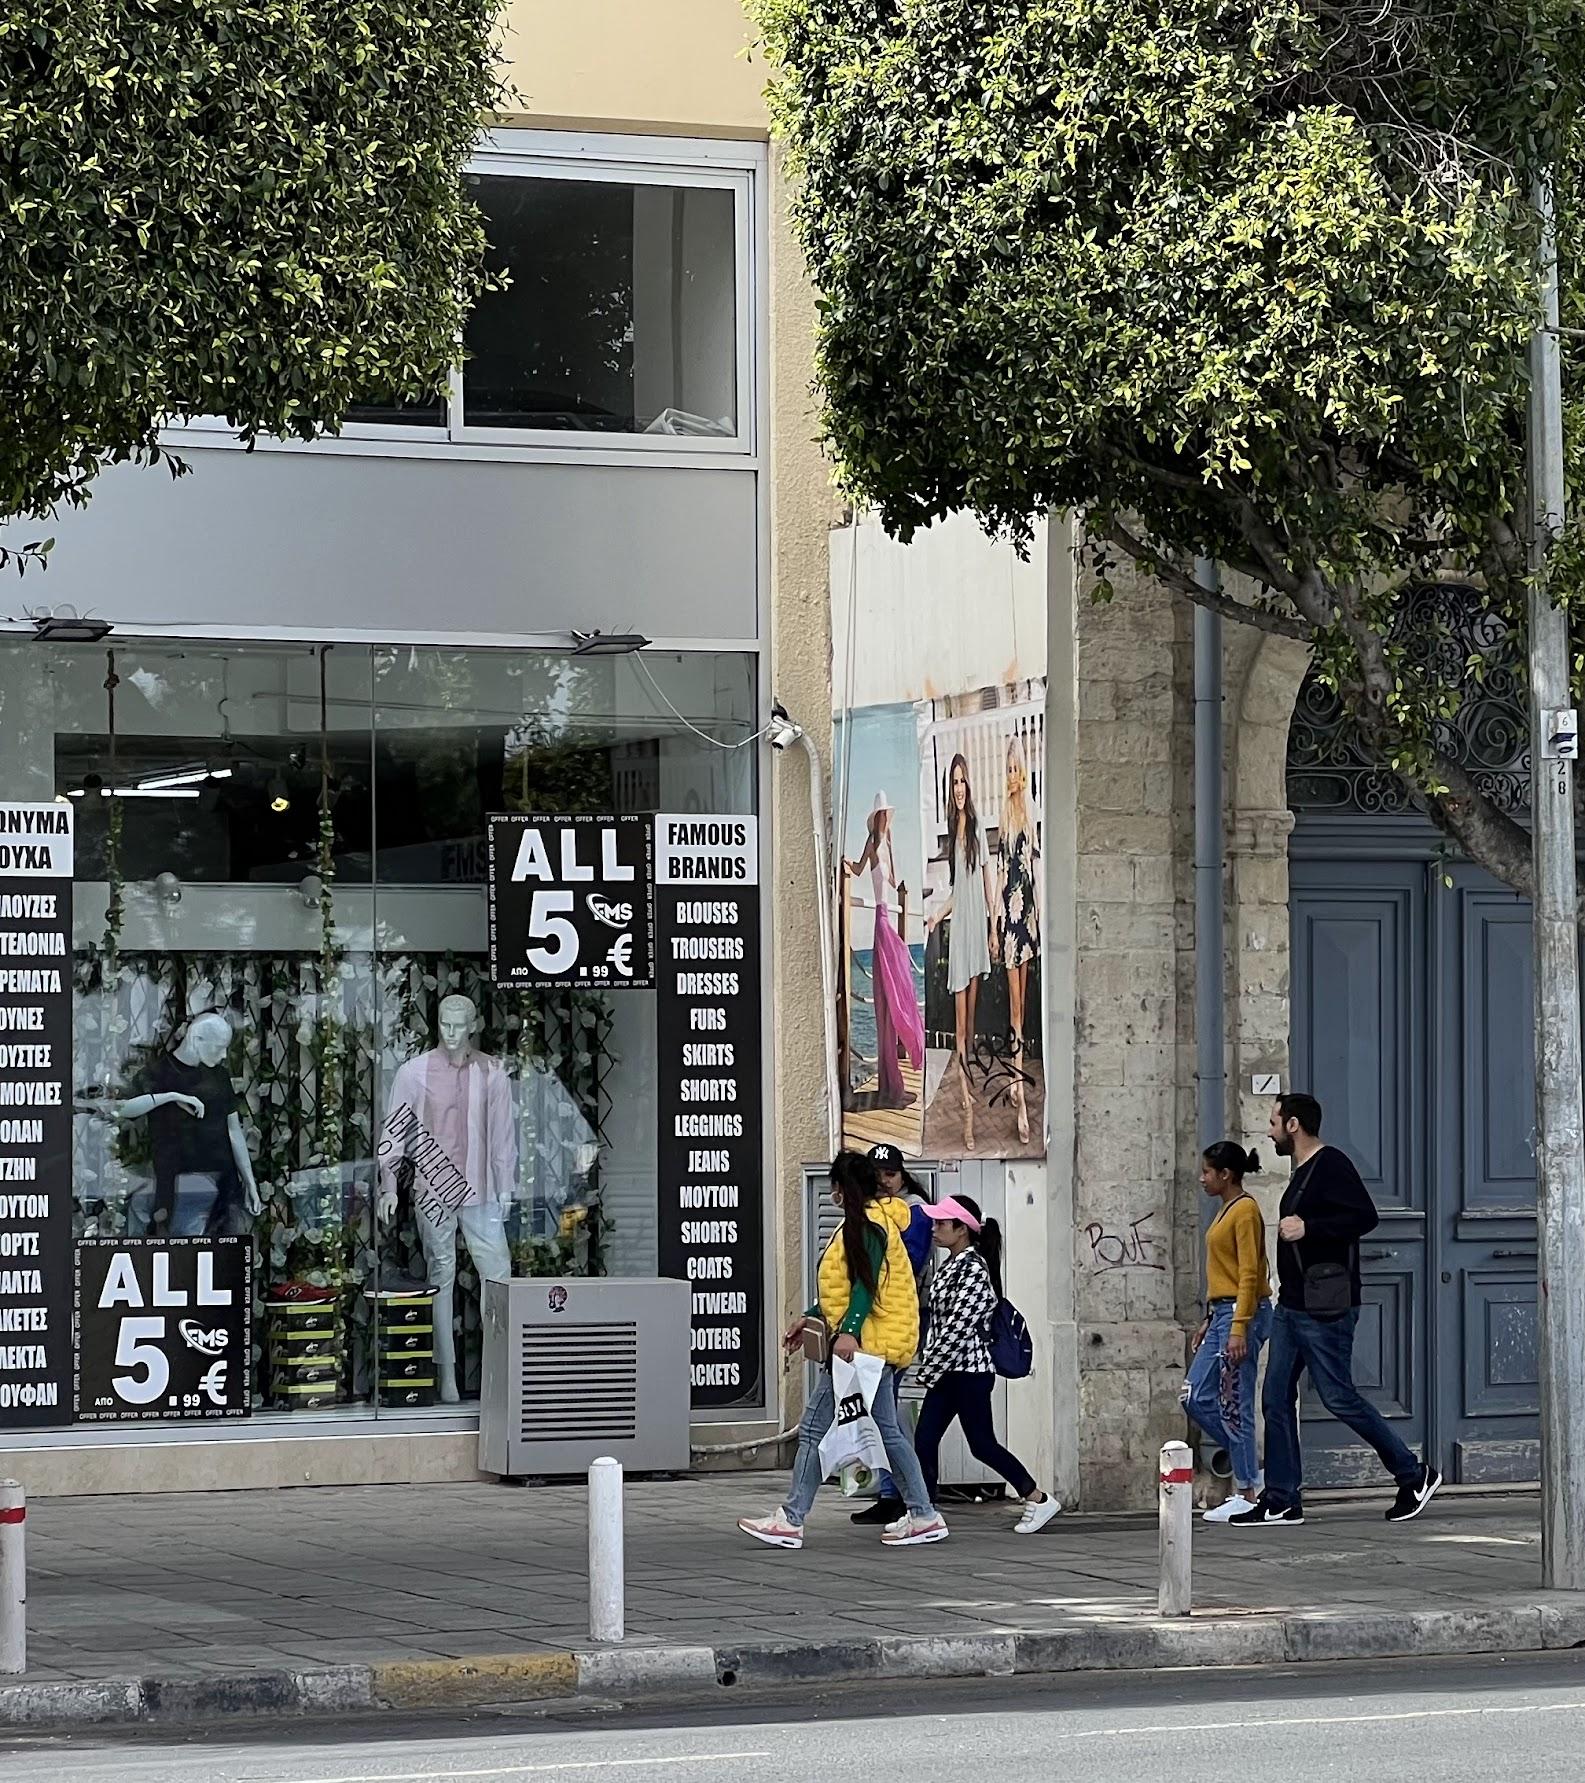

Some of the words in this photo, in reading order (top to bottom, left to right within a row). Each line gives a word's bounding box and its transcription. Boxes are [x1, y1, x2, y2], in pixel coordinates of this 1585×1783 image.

[668, 823, 746, 846] FAMOUS
[511, 828, 635, 882] ALL
[668, 856, 746, 880] BRANDS
[0, 894, 57, 919] ΛΟΥΖΕΣ
[594, 902, 633, 921] FMS
[676, 901, 739, 925] BLOUSES
[526, 890, 580, 974] 5
[670, 937, 744, 960] TROUSERS
[0, 969, 62, 993] ΡΕΜΑΤΑ
[676, 972, 739, 996] DRESSES
[690, 1007, 727, 1031] FURS
[682, 1043, 735, 1066] SKIRTS
[0, 1081, 62, 1106] ΜΟΥΔΕΣ
[680, 1078, 737, 1102] SHORTS
[674, 1114, 743, 1137] LEGGINGS
[405, 1131, 476, 1213] COLLECTION
[687, 1149, 730, 1173] JEANS
[679, 1185, 739, 1209] MOYTON
[680, 1220, 738, 1244] SHORTS
[0, 1232, 40, 1257] ΟΡΤΣ
[97, 1251, 232, 1309] ALL
[686, 1256, 733, 1281] COATS
[0, 1269, 43, 1294] ΑΛΤΑ
[692, 1291, 747, 1315] ITWEAR
[0, 1307, 48, 1332] ΚΕΤΕΣ
[186, 1328, 229, 1348] FMS
[689, 1327, 741, 1351] OOTERS
[111, 1316, 170, 1405] 5
[689, 1362, 740, 1386] ACKETS
[0, 1382, 58, 1408] ΟΥΦΑΝ
